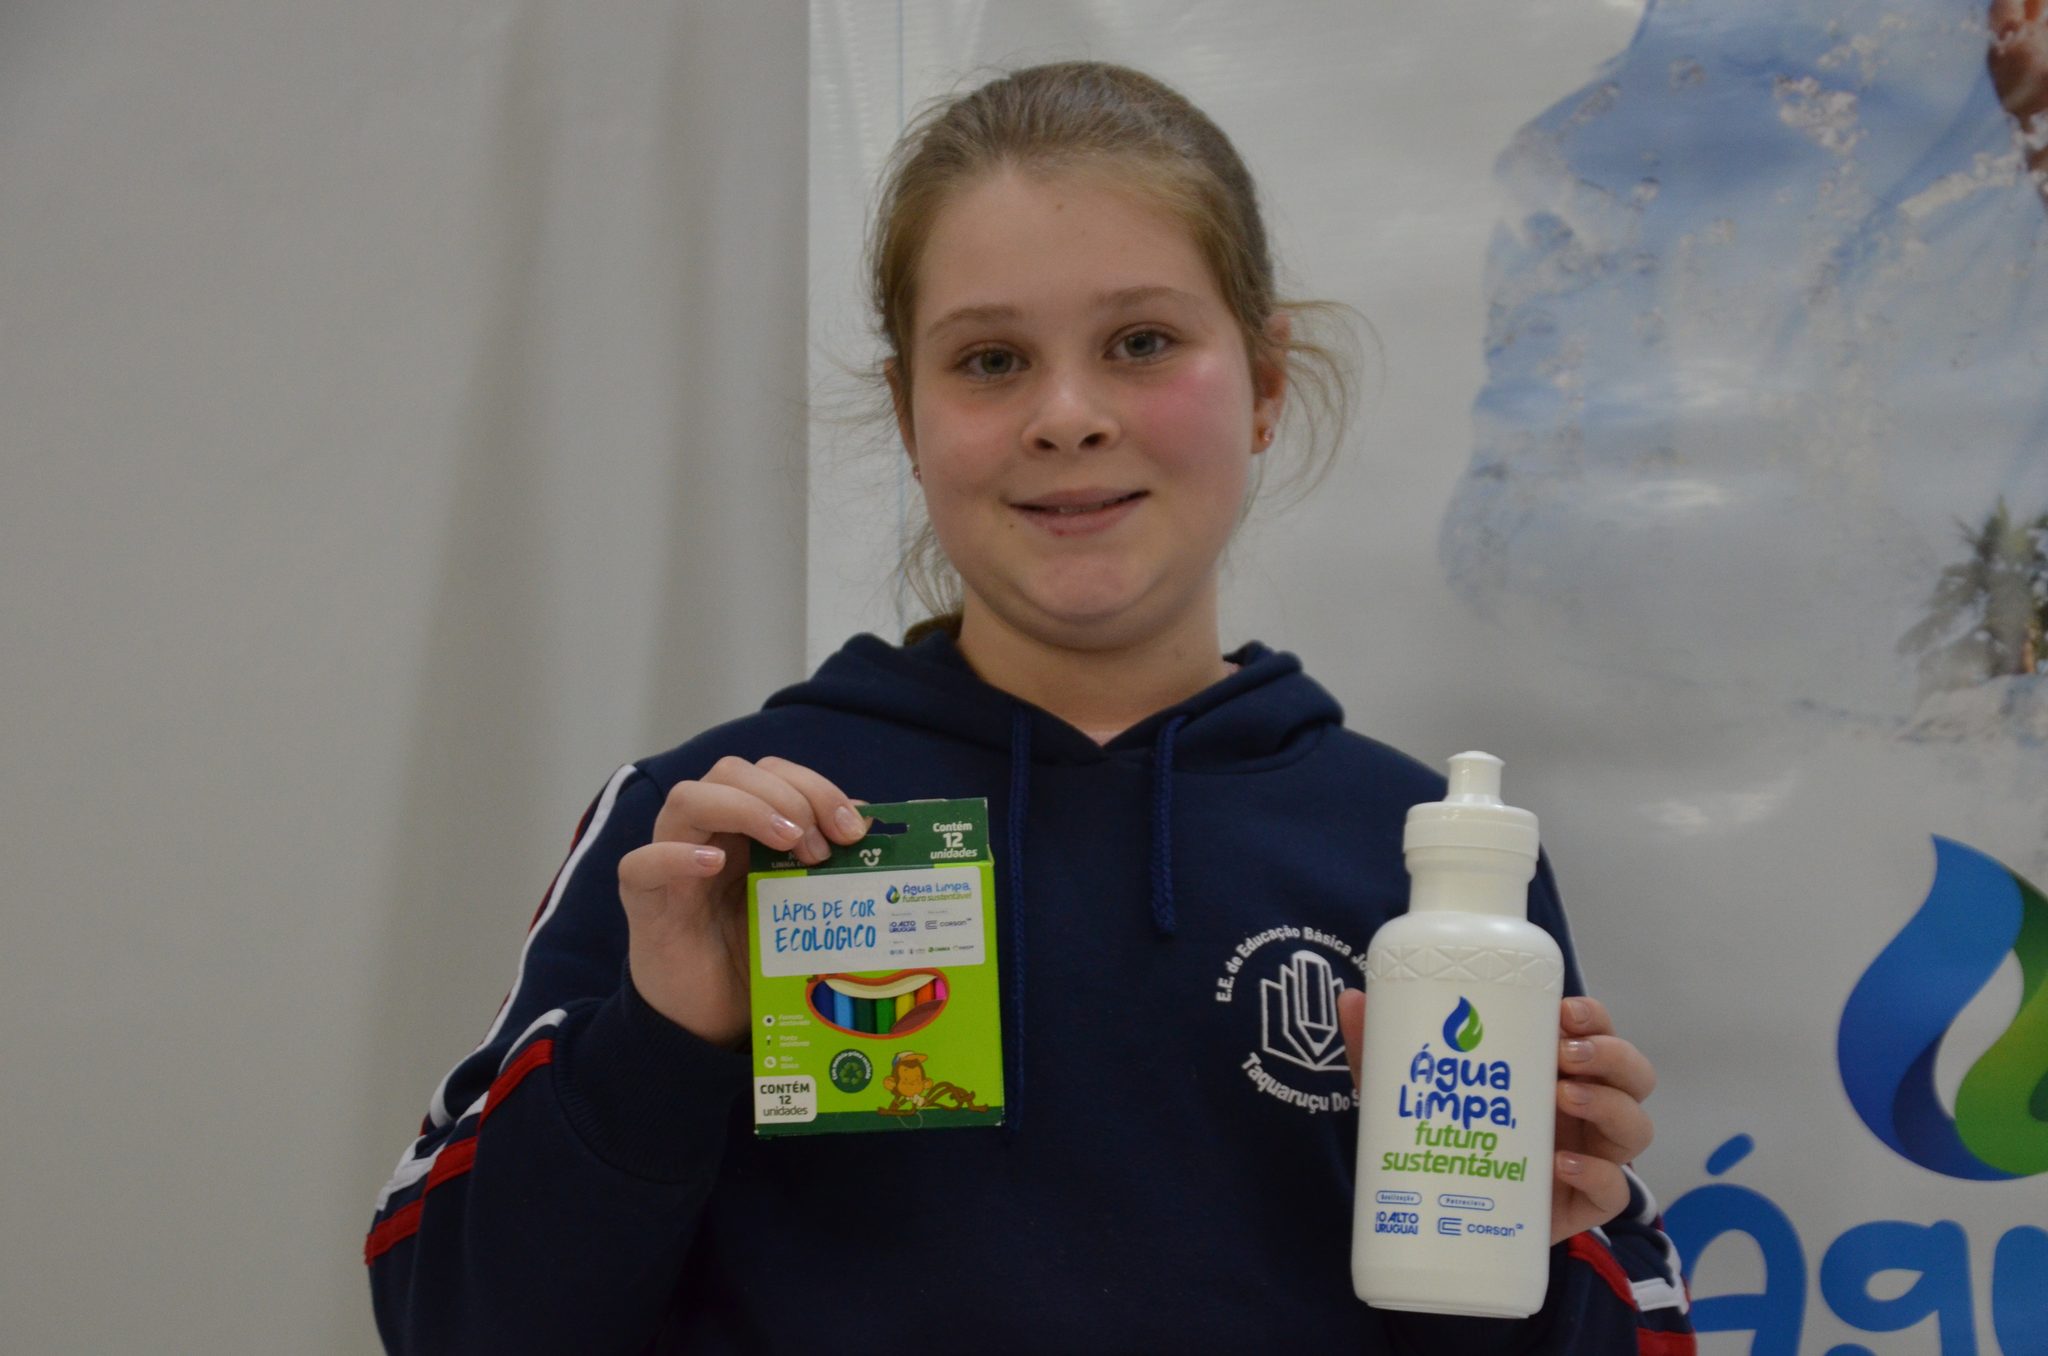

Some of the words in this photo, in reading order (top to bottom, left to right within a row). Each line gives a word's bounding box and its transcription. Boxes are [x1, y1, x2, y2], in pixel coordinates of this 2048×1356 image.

[933, 820, 973, 832] Contém
[942, 832, 964, 848] 12
[930, 848, 978, 860] unidades
[772, 899, 817, 923] LÁPIS
[822, 900, 843, 919] DE
[850, 898, 876, 918] COR
[775, 921, 877, 953] ECOLÓGICO
[1226, 956, 1243, 974] de
[1236, 925, 1300, 959] Educação
[1303, 926, 1352, 957] Básica
[1352, 953, 1368, 971] Jo
[1410, 1043, 1511, 1092] Água
[760, 1081, 810, 1094] CONTÉM
[1241, 1052, 1329, 1114] Taquaruçu
[1331, 1091, 1350, 1112] Do
[779, 1095, 792, 1105] 12
[763, 1105, 808, 1117] unidades
[1414, 1120, 1498, 1152] futuro
[1381, 1150, 1527, 1182] sustentável
[1388, 1211, 1419, 1224] ALTO
[1375, 1223, 1419, 1235] URUGUAI
